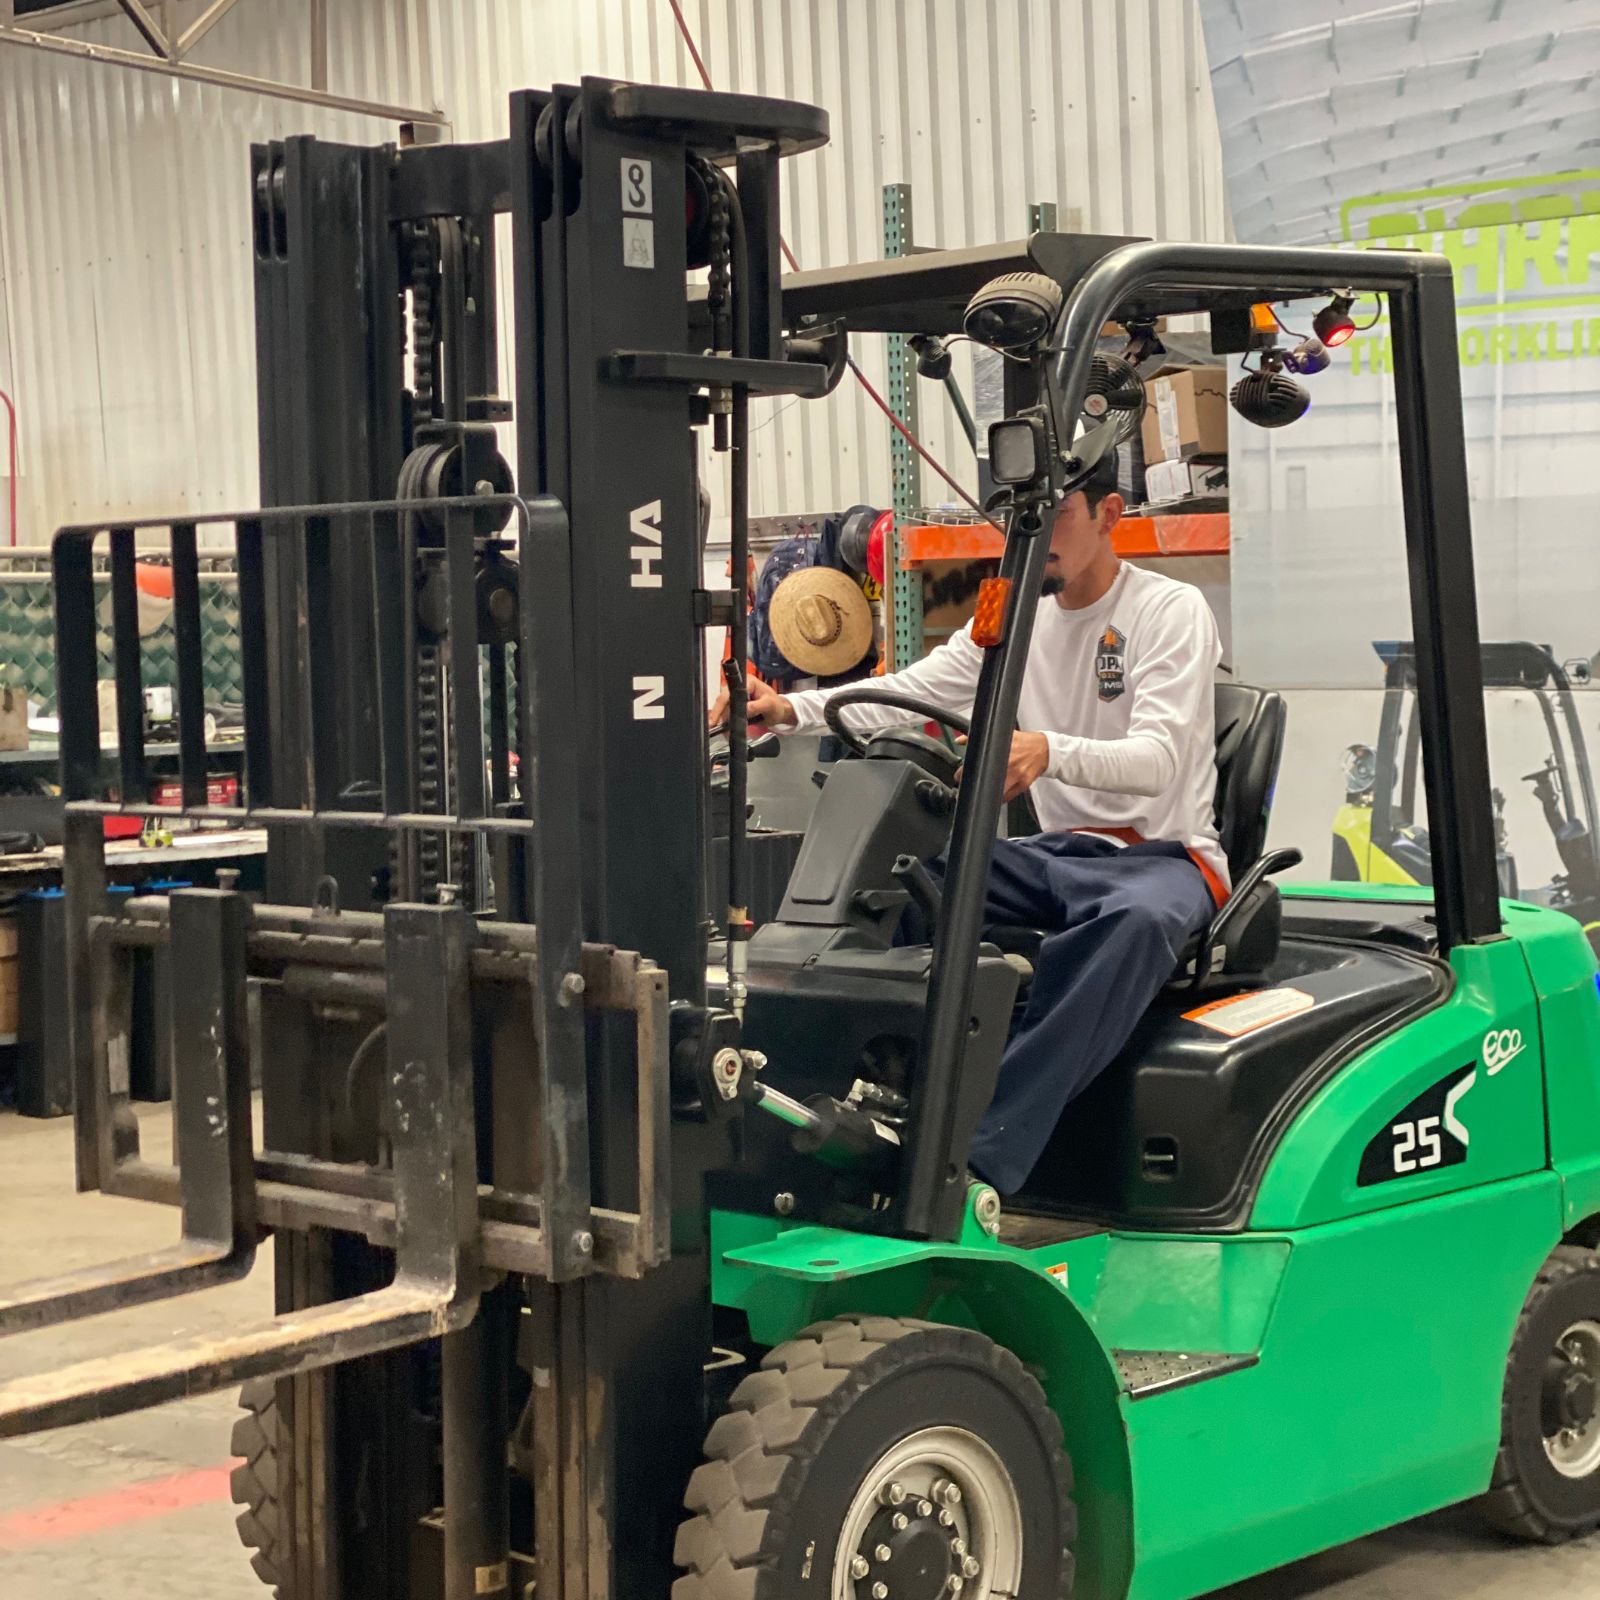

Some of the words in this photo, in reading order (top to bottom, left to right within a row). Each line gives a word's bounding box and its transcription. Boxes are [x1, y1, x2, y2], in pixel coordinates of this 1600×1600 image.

[1460, 317, 1600, 367] ORKLI
[629, 499, 663, 588] HA
[1481, 1028, 1523, 1068] eco
[1392, 1115, 1442, 1173] 25
